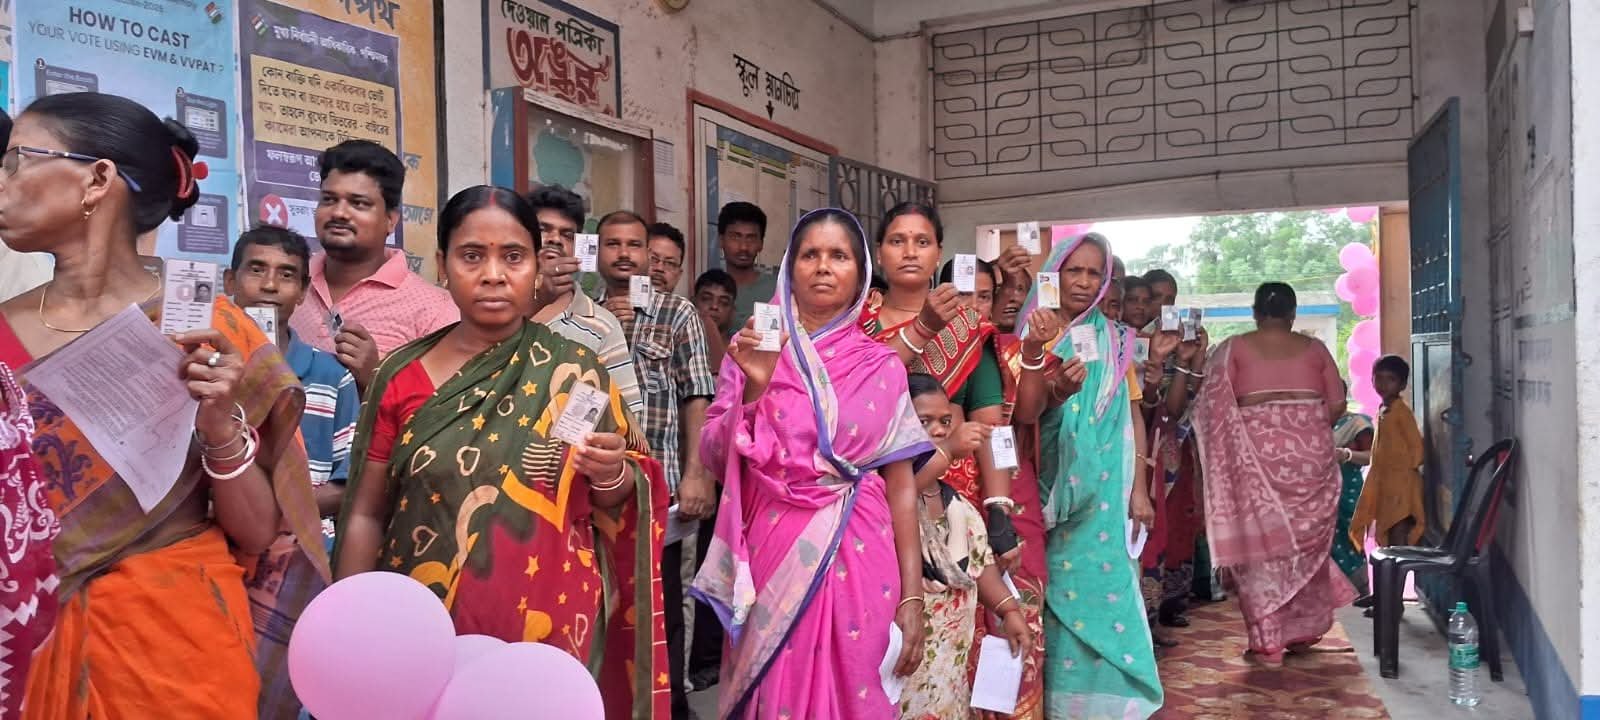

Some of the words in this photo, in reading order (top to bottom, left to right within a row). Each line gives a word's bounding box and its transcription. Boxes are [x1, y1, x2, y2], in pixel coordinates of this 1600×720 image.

[28, 21, 65, 40] YOUR
[68, 30, 101, 48] VOTE
[104, 39, 141, 56] USING
[143, 46, 168, 62] EVM
[169, 53, 177, 65] &
[180, 55, 217, 73] VVPAT
[69, 6, 115, 32] HOW
[120, 18, 144, 38] TO
[148, 26, 190, 49] CAST
[555, 18, 605, 55] পত্রিকা
[262, 66, 283, 77] কোন
[733, 53, 760, 97] স্কুল
